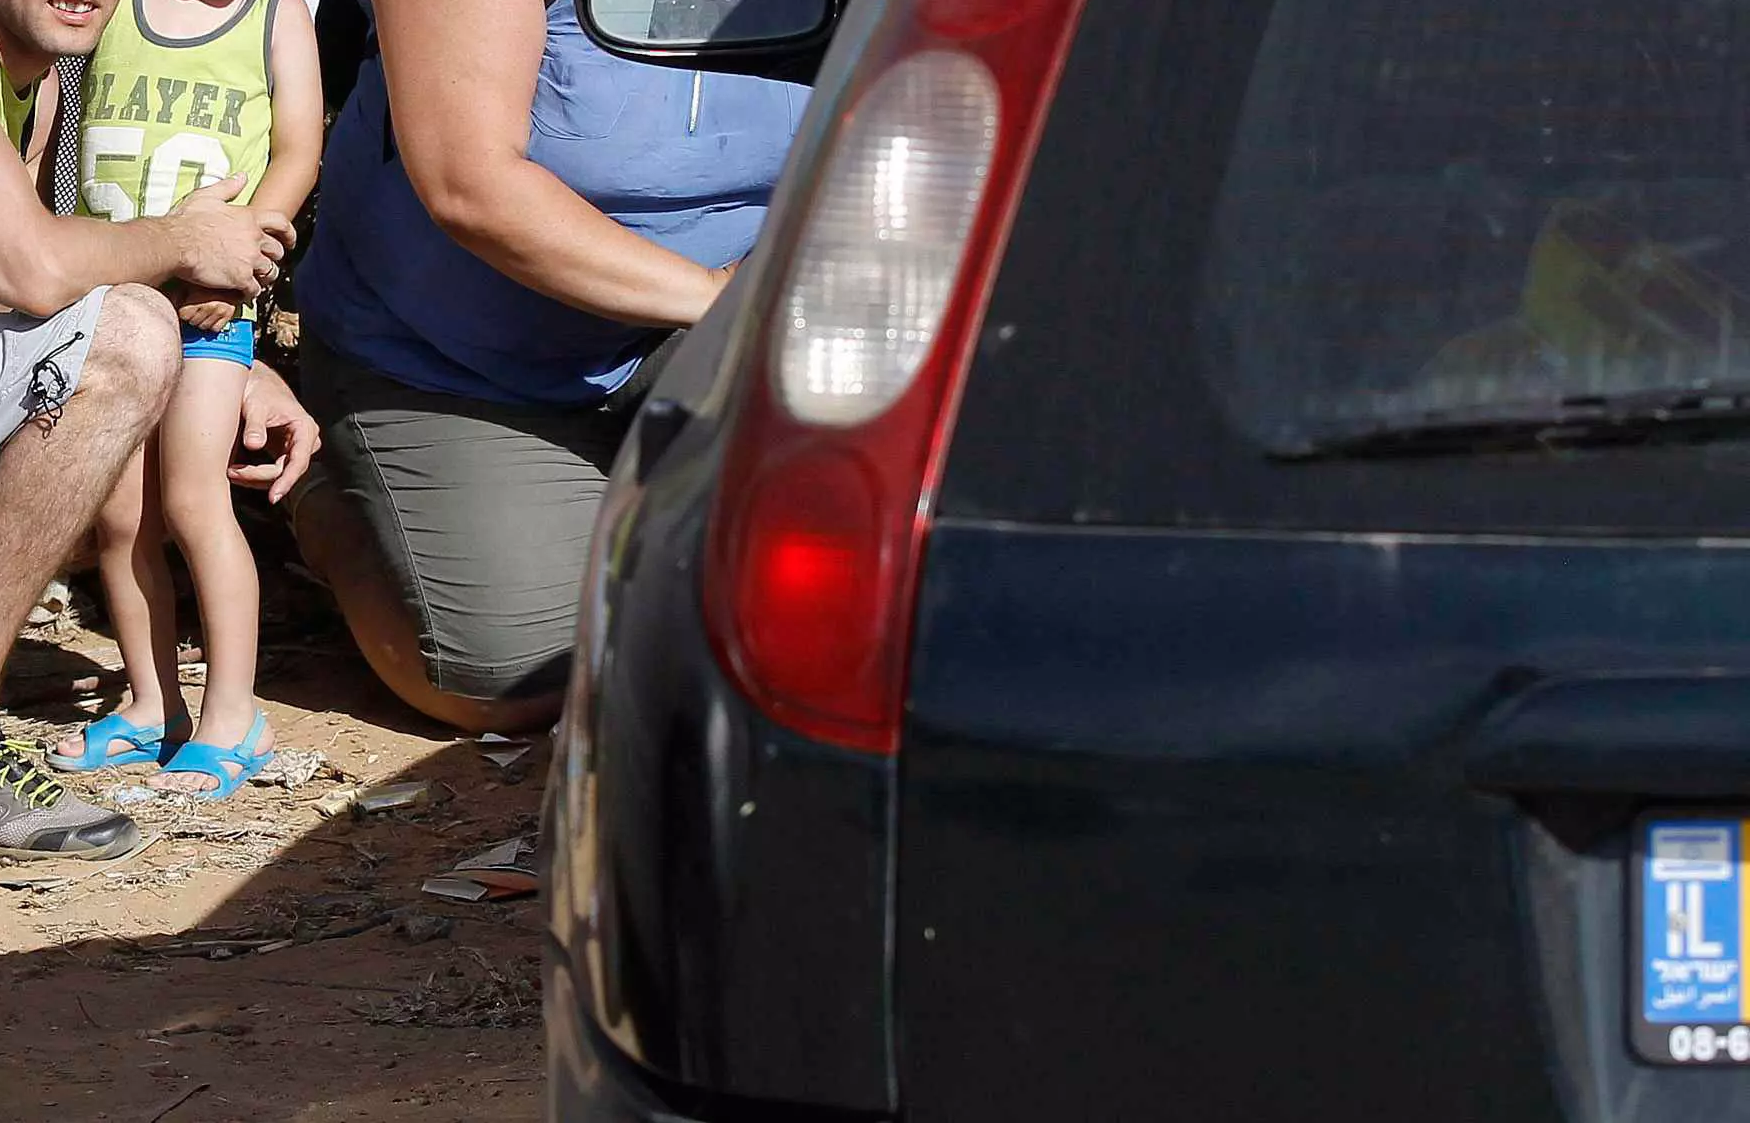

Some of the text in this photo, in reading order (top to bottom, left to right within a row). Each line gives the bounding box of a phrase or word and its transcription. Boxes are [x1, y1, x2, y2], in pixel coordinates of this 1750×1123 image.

[82, 73, 247, 137] PLAYER
[82, 126, 231, 222] 50
[1666, 882, 1723, 957] IL
